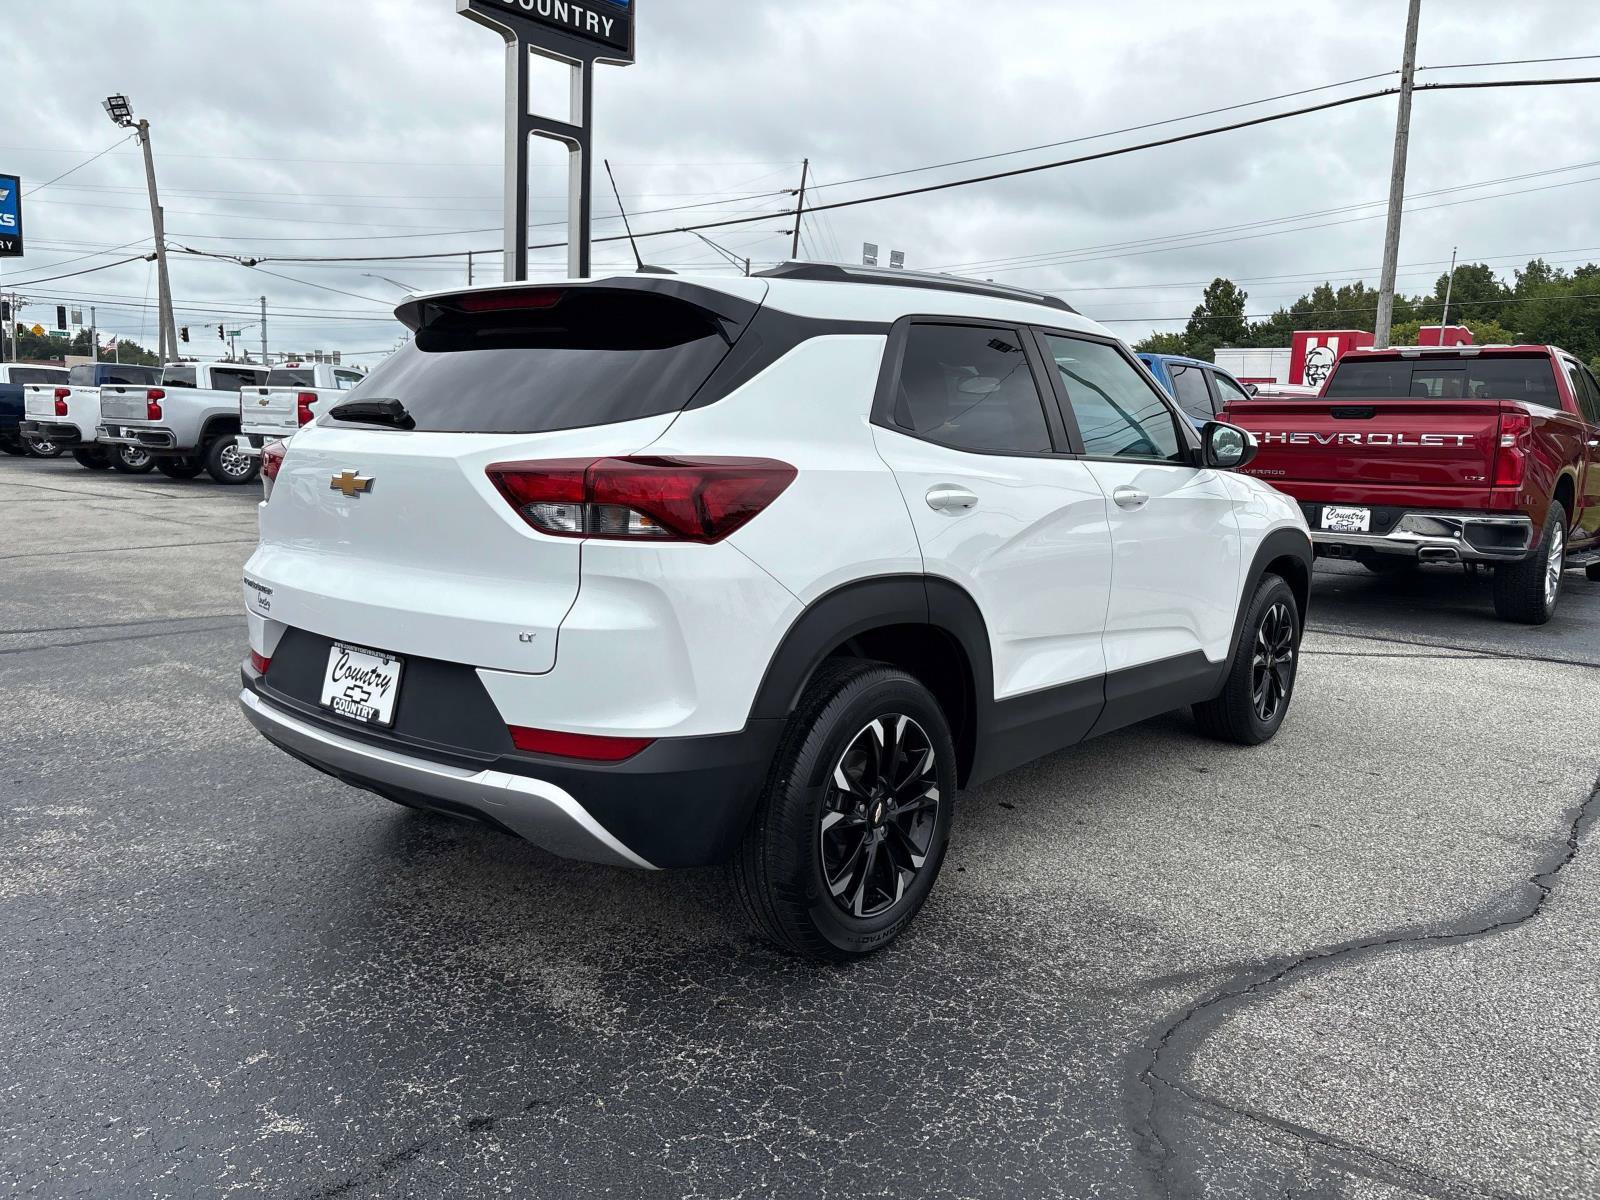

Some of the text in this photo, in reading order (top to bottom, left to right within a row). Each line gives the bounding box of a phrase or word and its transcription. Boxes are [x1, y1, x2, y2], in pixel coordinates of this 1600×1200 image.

[505, 0, 614, 37] OUNTRY
[1326, 509, 1366, 523] Country
[519, 632, 536, 643] LT
[332, 652, 392, 698] Country
[333, 697, 375, 719] COUNTRY
